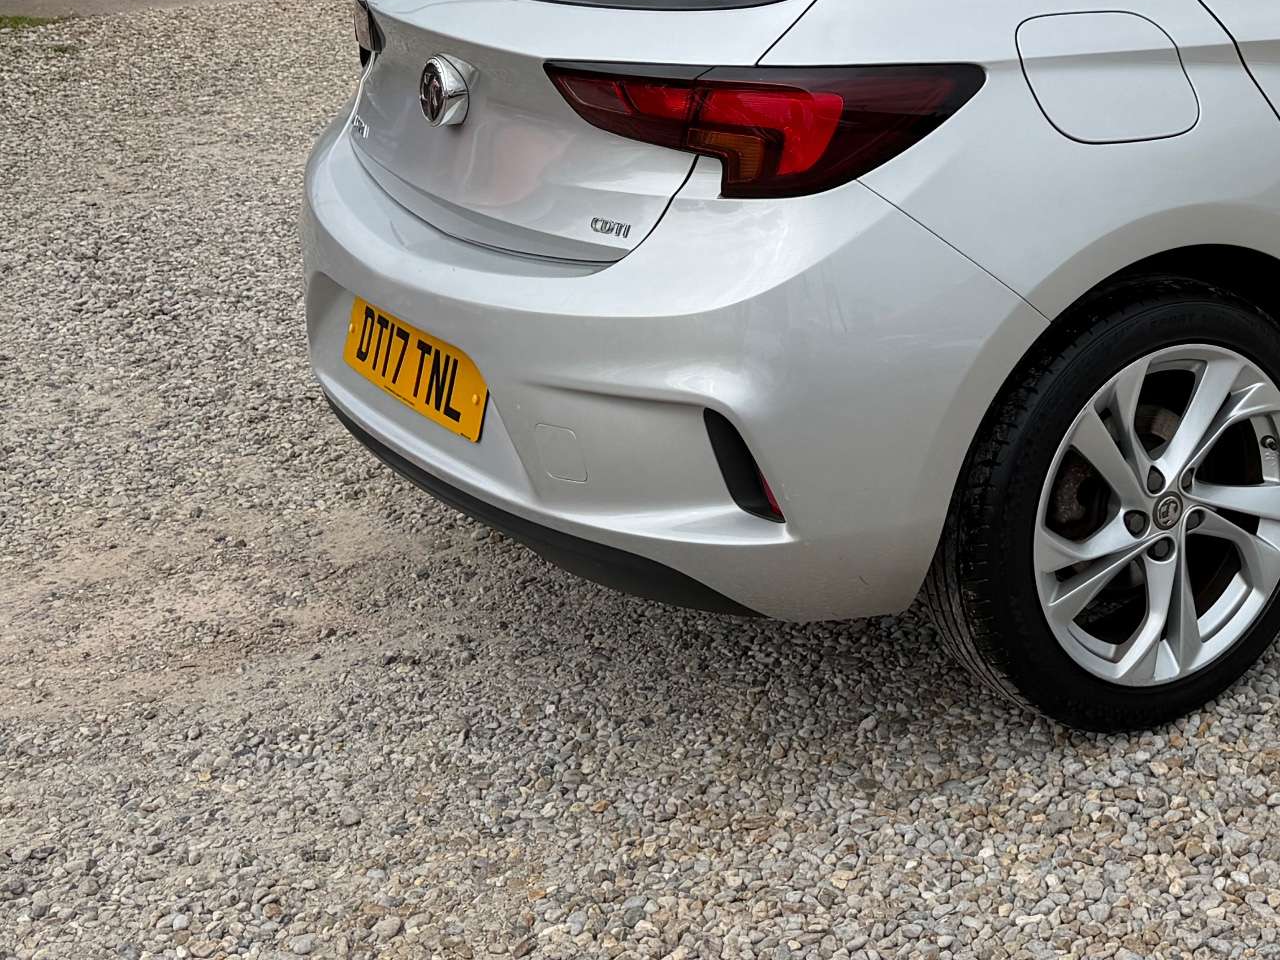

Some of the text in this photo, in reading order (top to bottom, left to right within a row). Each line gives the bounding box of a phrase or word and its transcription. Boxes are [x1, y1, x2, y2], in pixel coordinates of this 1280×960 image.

[591, 217, 631, 238] CDTI
[356, 305, 461, 423] DT17 TNL
